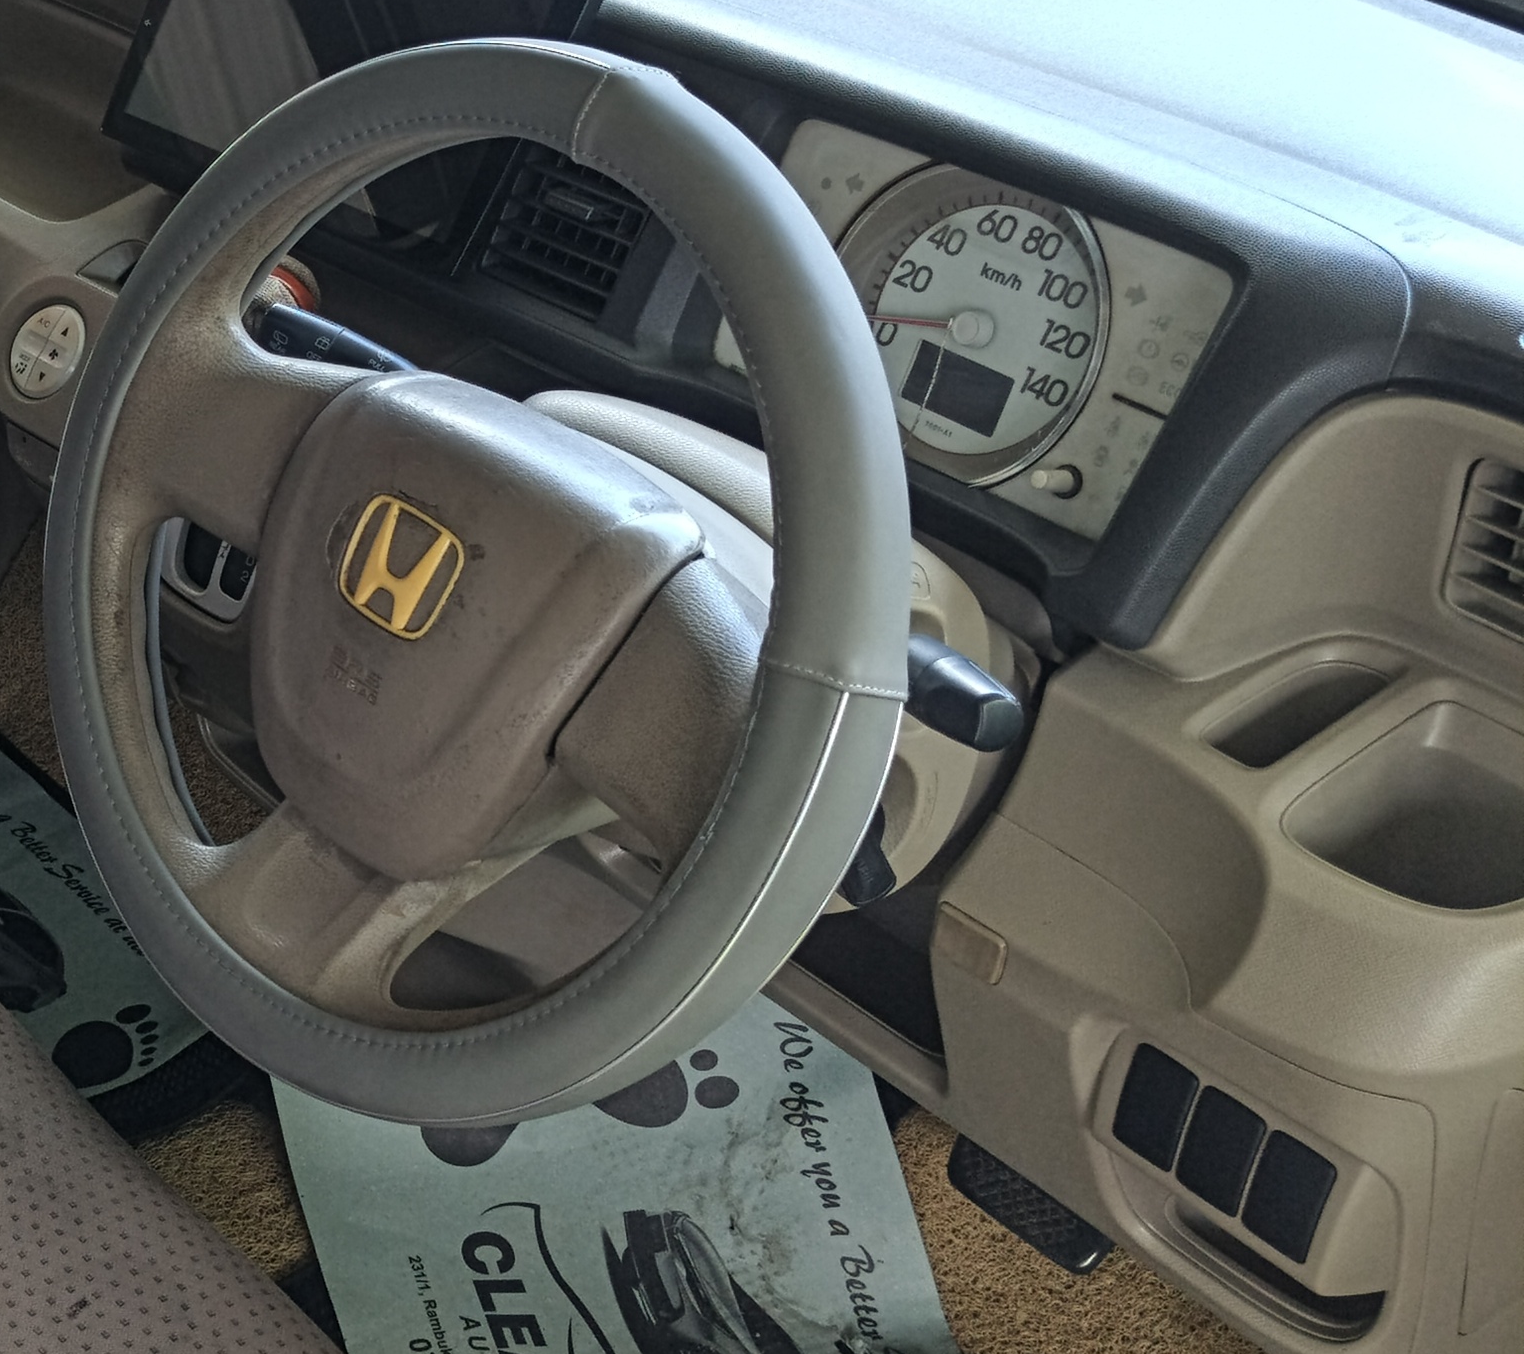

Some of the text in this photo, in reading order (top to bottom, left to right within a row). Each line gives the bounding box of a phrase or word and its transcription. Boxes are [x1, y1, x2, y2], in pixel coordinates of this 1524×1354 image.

[926, 223, 968, 256] 40
[976, 209, 1019, 243] 60
[1020, 225, 1064, 261] 80
[891, 258, 934, 293] 20
[979, 261, 1023, 292] km/h
[1036, 268, 1089, 309] 100
[305, 350, 323, 362] OFF
[1039, 318, 1092, 359] 120
[367, 358, 386, 373] PULL
[1019, 365, 1070, 408] 140
[10, 820, 59, 865] Better
[43, 862, 111, 916] Service
[103, 917, 129, 933] at
[773, 1021, 814, 1073] We
[779, 1080, 829, 1153] offer
[800, 1161, 842, 1209] you
[827, 1218, 850, 1237] a
[840, 1244, 884, 1342] Better
